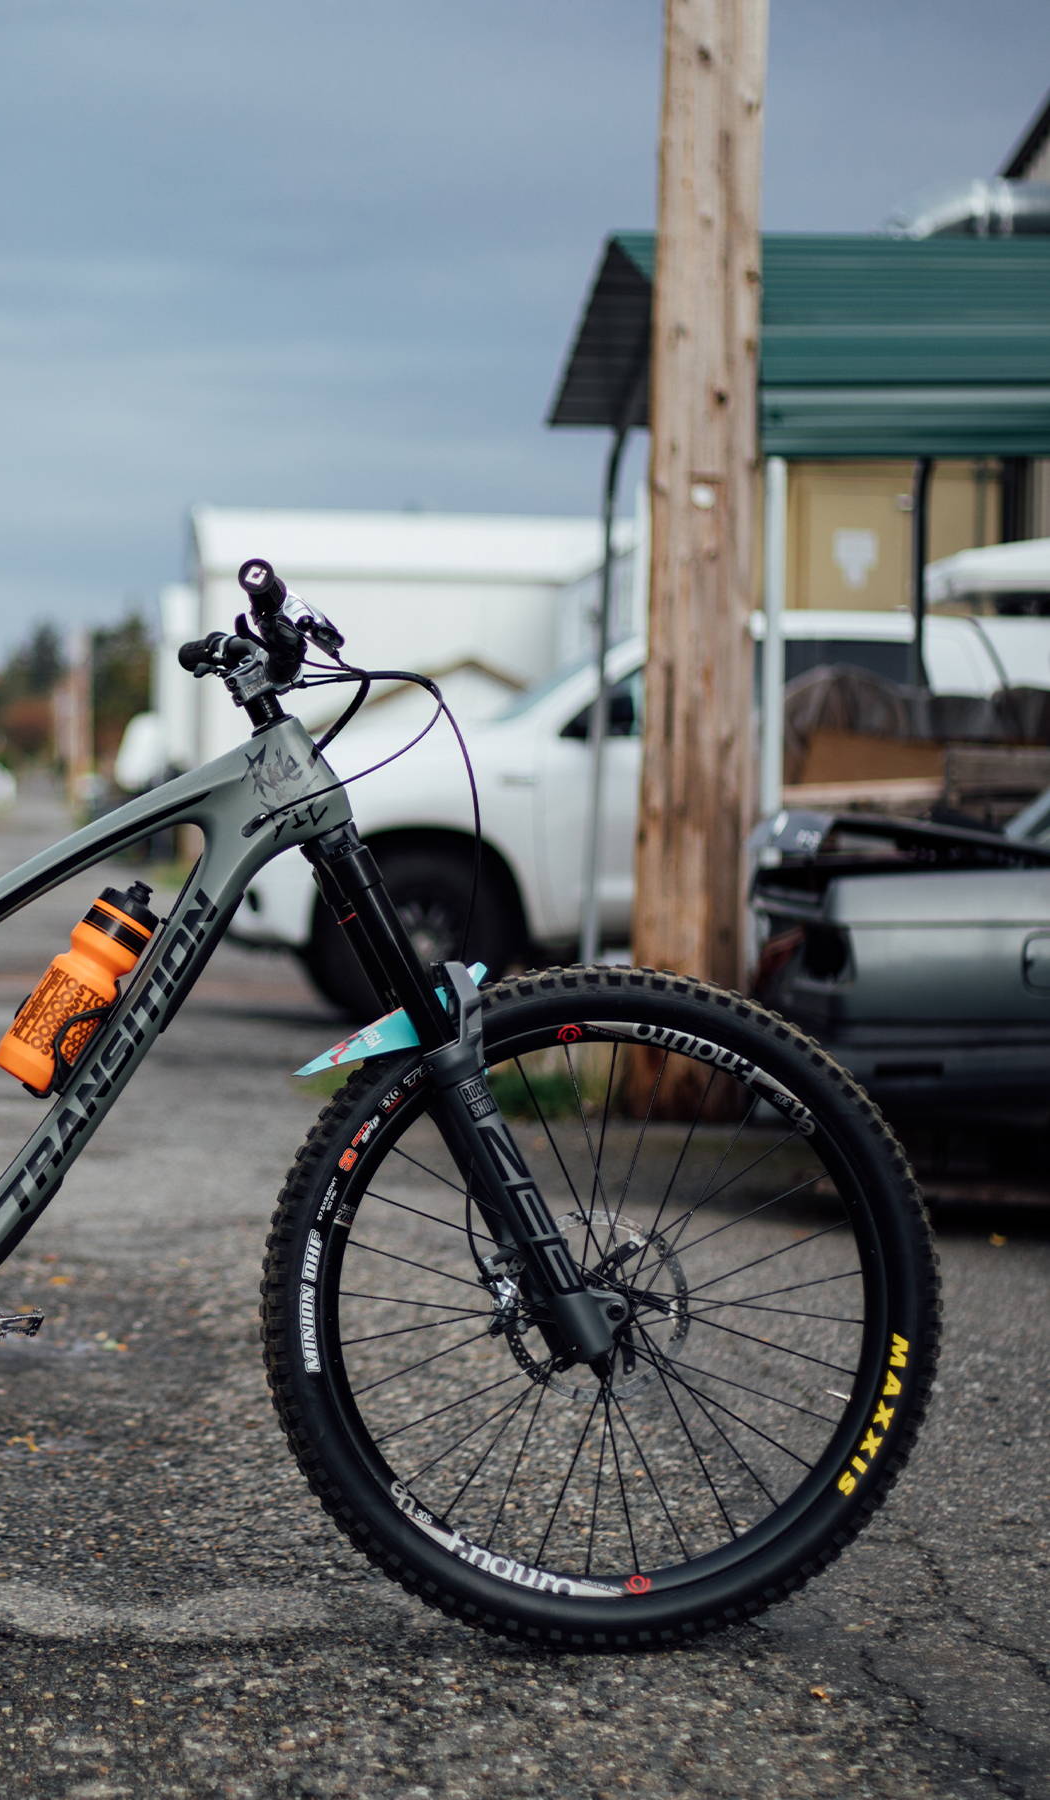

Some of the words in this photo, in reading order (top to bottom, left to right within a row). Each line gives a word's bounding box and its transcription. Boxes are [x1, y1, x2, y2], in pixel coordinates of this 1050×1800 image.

[632, 1023, 761, 1086] Enduro
[380, 1087, 401, 1110] EXO
[773, 1092, 792, 1108] 305
[477, 1122, 587, 1295] ZEB
[301, 1228, 323, 1282] DHF
[299, 1283, 322, 1373] MINION
[838, 1333, 910, 1497] MAXXIS
[414, 1508, 434, 1525] 305
[450, 1529, 575, 1596] Enduro
